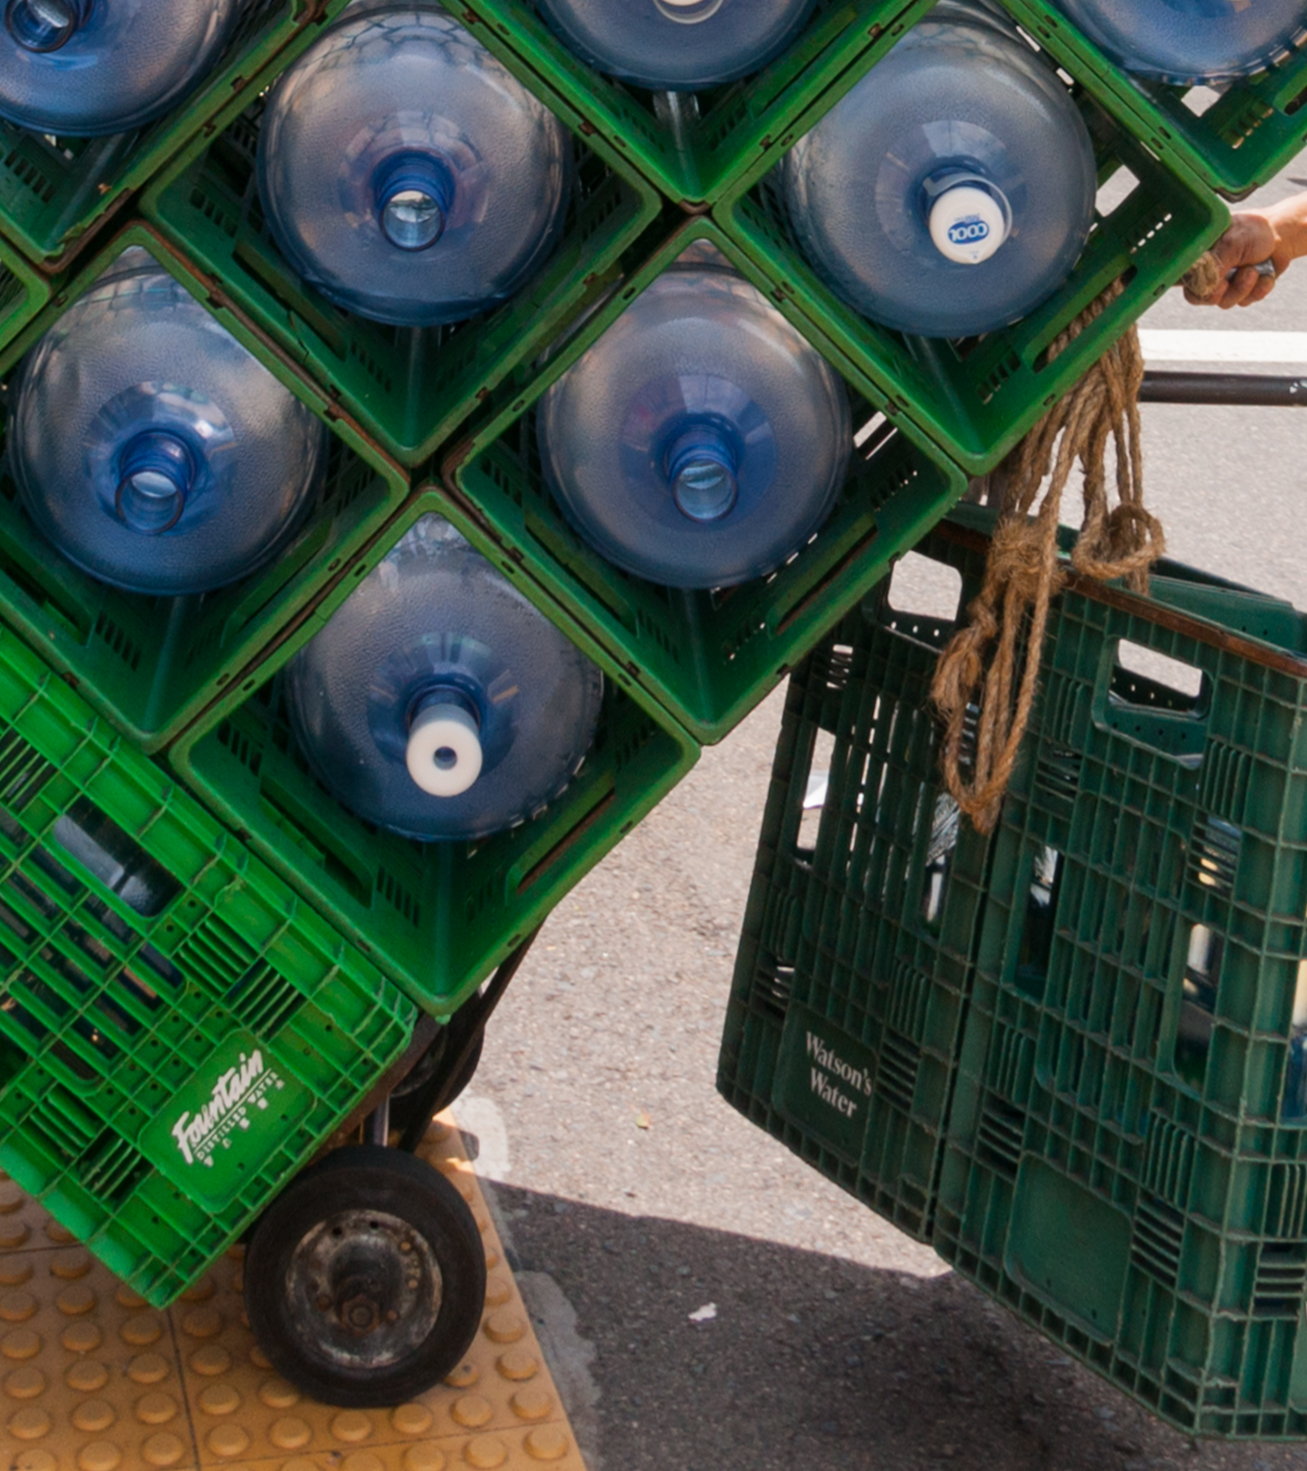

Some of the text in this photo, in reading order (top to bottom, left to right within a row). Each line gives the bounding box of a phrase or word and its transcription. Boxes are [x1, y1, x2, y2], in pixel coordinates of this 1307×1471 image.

[806, 1031, 872, 1097] Watson's
[811, 1067, 858, 1119] Water
[171, 1049, 264, 1166] Fountain
